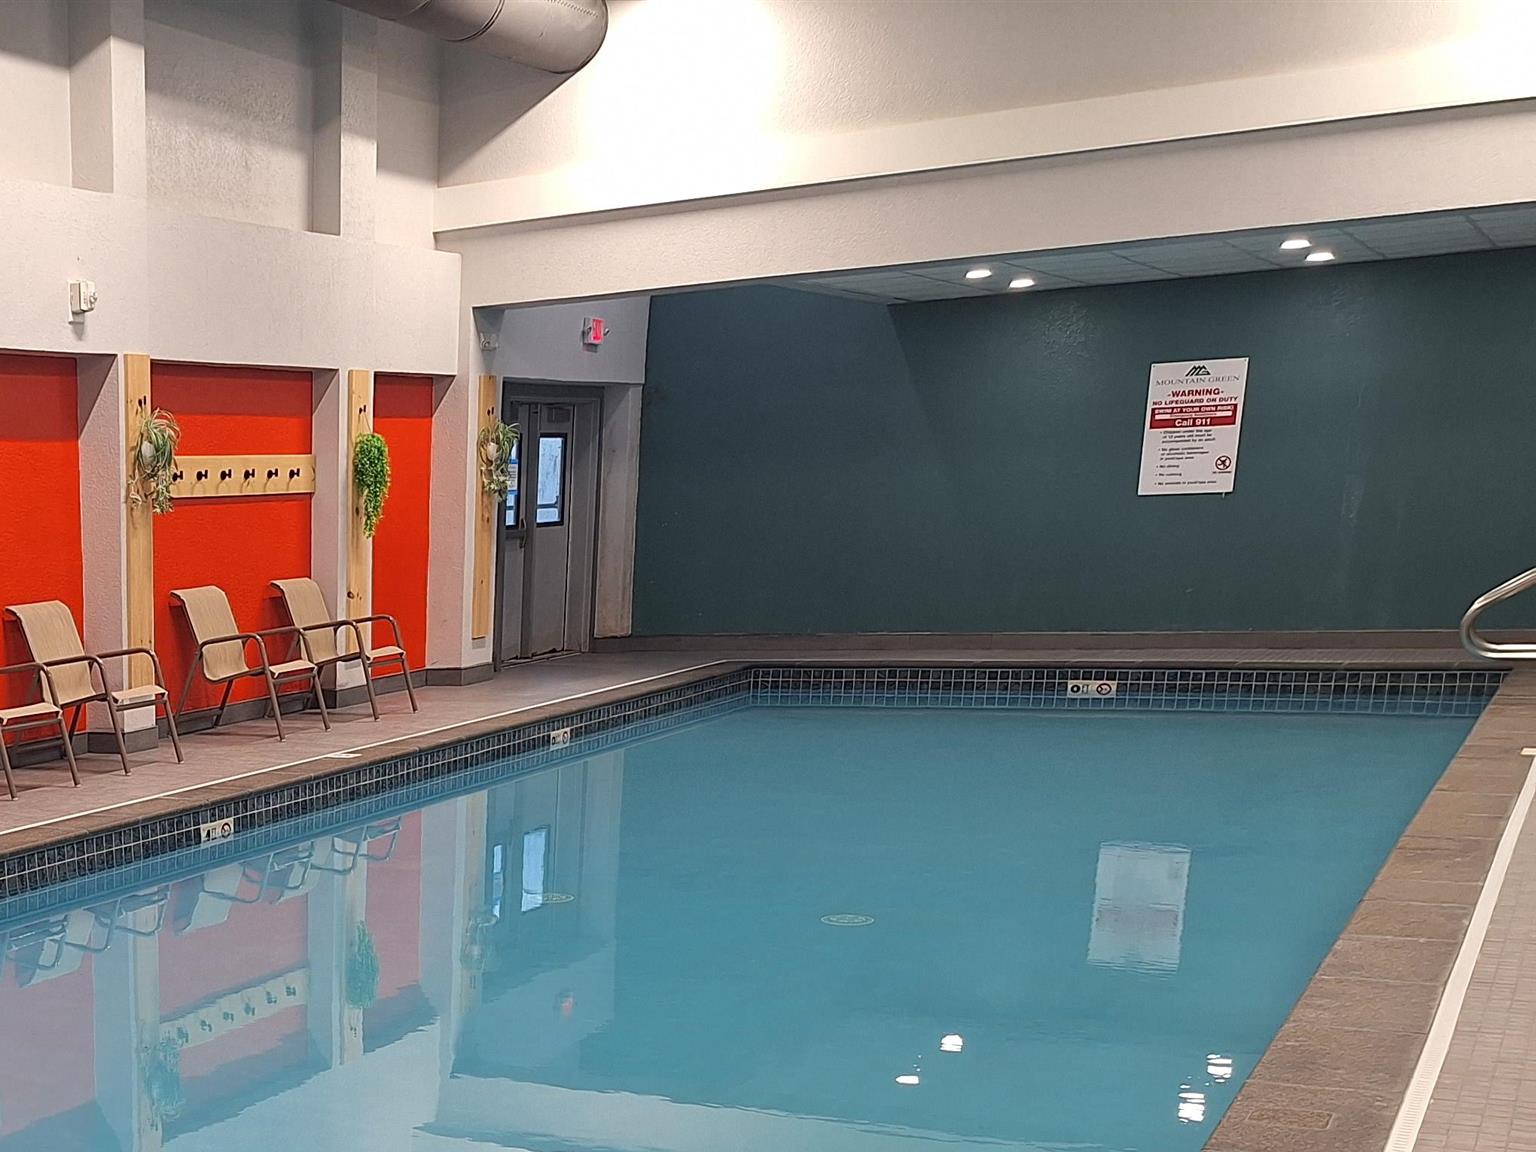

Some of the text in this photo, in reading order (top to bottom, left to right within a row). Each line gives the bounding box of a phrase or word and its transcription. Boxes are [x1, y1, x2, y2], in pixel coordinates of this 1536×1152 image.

[1155, 375, 1240, 386] MOUNTAIN GREEN
[1164, 398, 1204, 406] LIFEGUARD
[1175, 418, 1211, 427] Call 911
